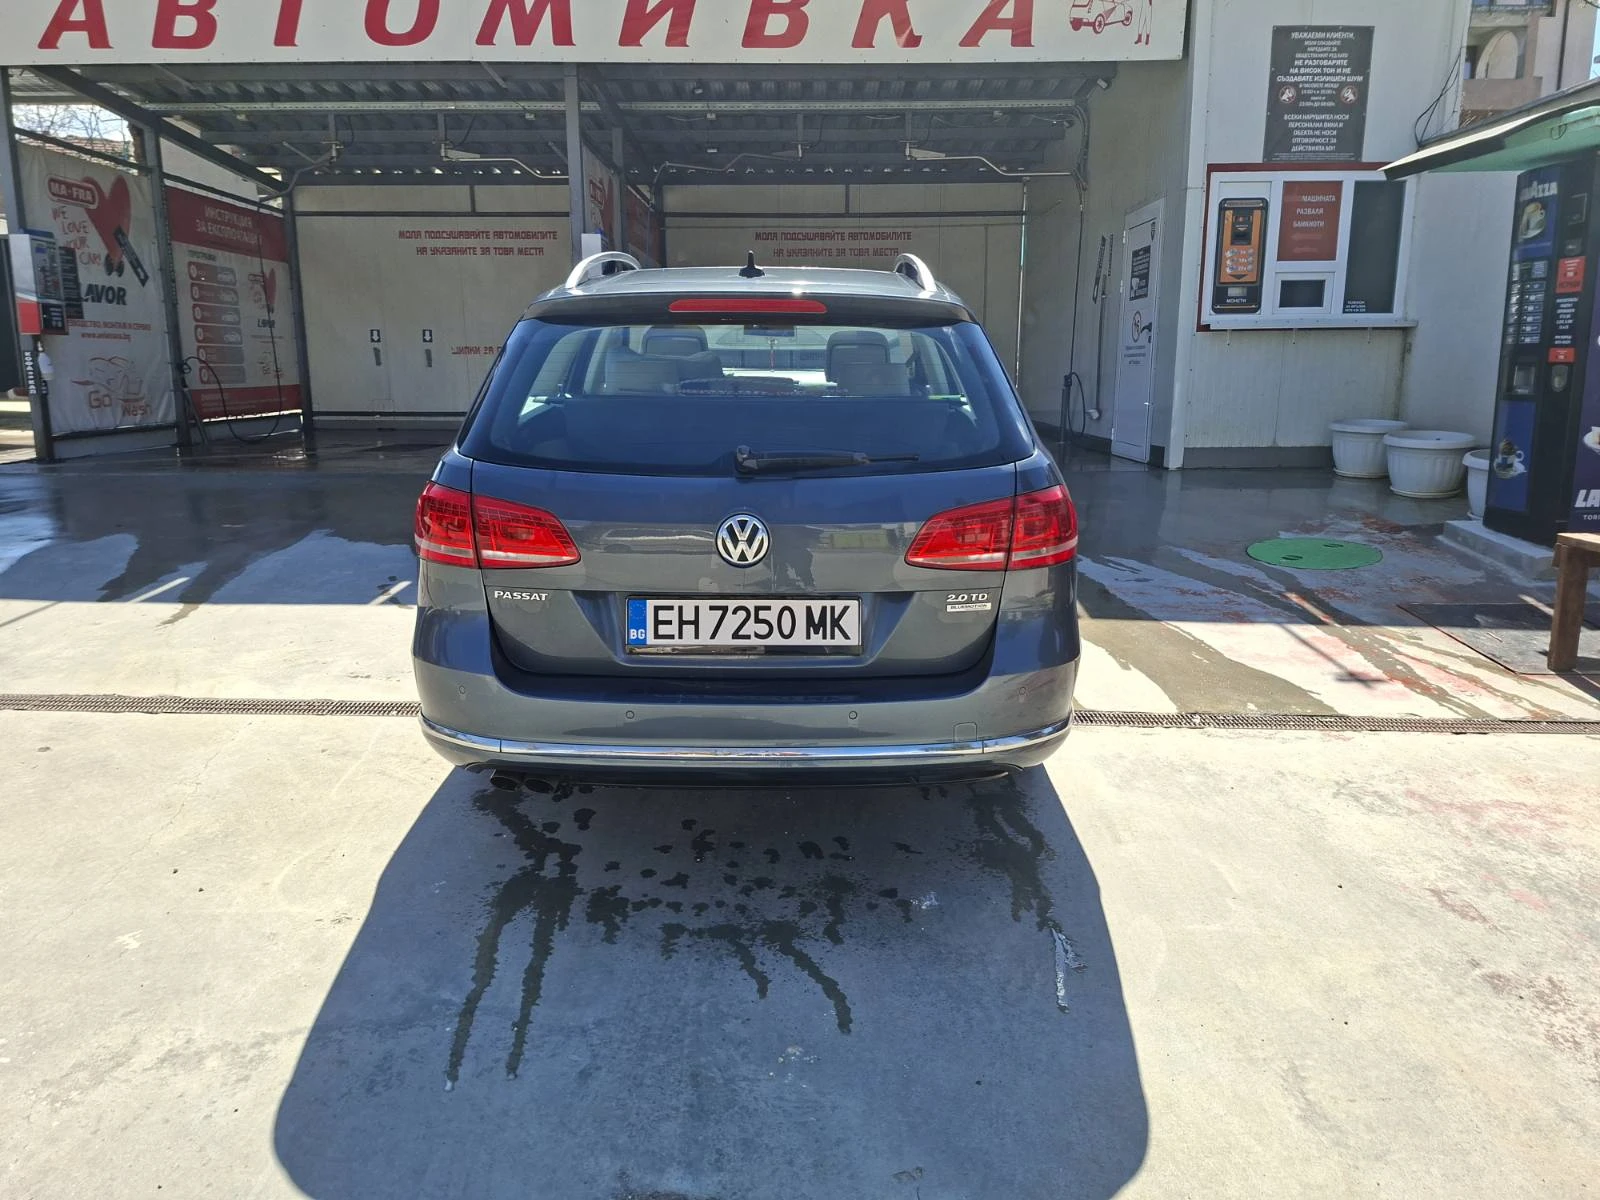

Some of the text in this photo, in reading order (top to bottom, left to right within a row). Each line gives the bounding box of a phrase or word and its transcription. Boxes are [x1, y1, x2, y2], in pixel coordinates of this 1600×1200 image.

[1291, 31, 1325, 39] УВАЖАЕМИ
[50, 181, 94, 202] MA-FRA
[1302, 194, 1337, 202] МАШИНАТА
[1296, 207, 1324, 215] РАЗВАЛЯ
[61, 219, 90, 236] LOVE
[1292, 220, 1325, 228] БАНКНОТИ
[398, 228, 558, 240] МОЛЯ ПОДСУШАВАЙТЕ АВТОМОБИЛИТЕ
[755, 230, 912, 241] МОЛЯ ПОДСУШАВАЙТЕ АВТОМОБИЛИТЕ
[416, 246, 545, 256] НА УКАЗАНИТЕ ЗА ТОВА МЕСТА
[773, 247, 899, 257] НА УКАЗАНИТЕ ЗА ТОВА МЕСТА
[83, 282, 127, 306] AVOR
[88, 390, 113, 410] Go
[494, 590, 549, 601] PASSAT
[946, 593, 968, 602] 2.0
[653, 605, 851, 641] EH 7250 MK
[629, 629, 645, 640] BG
